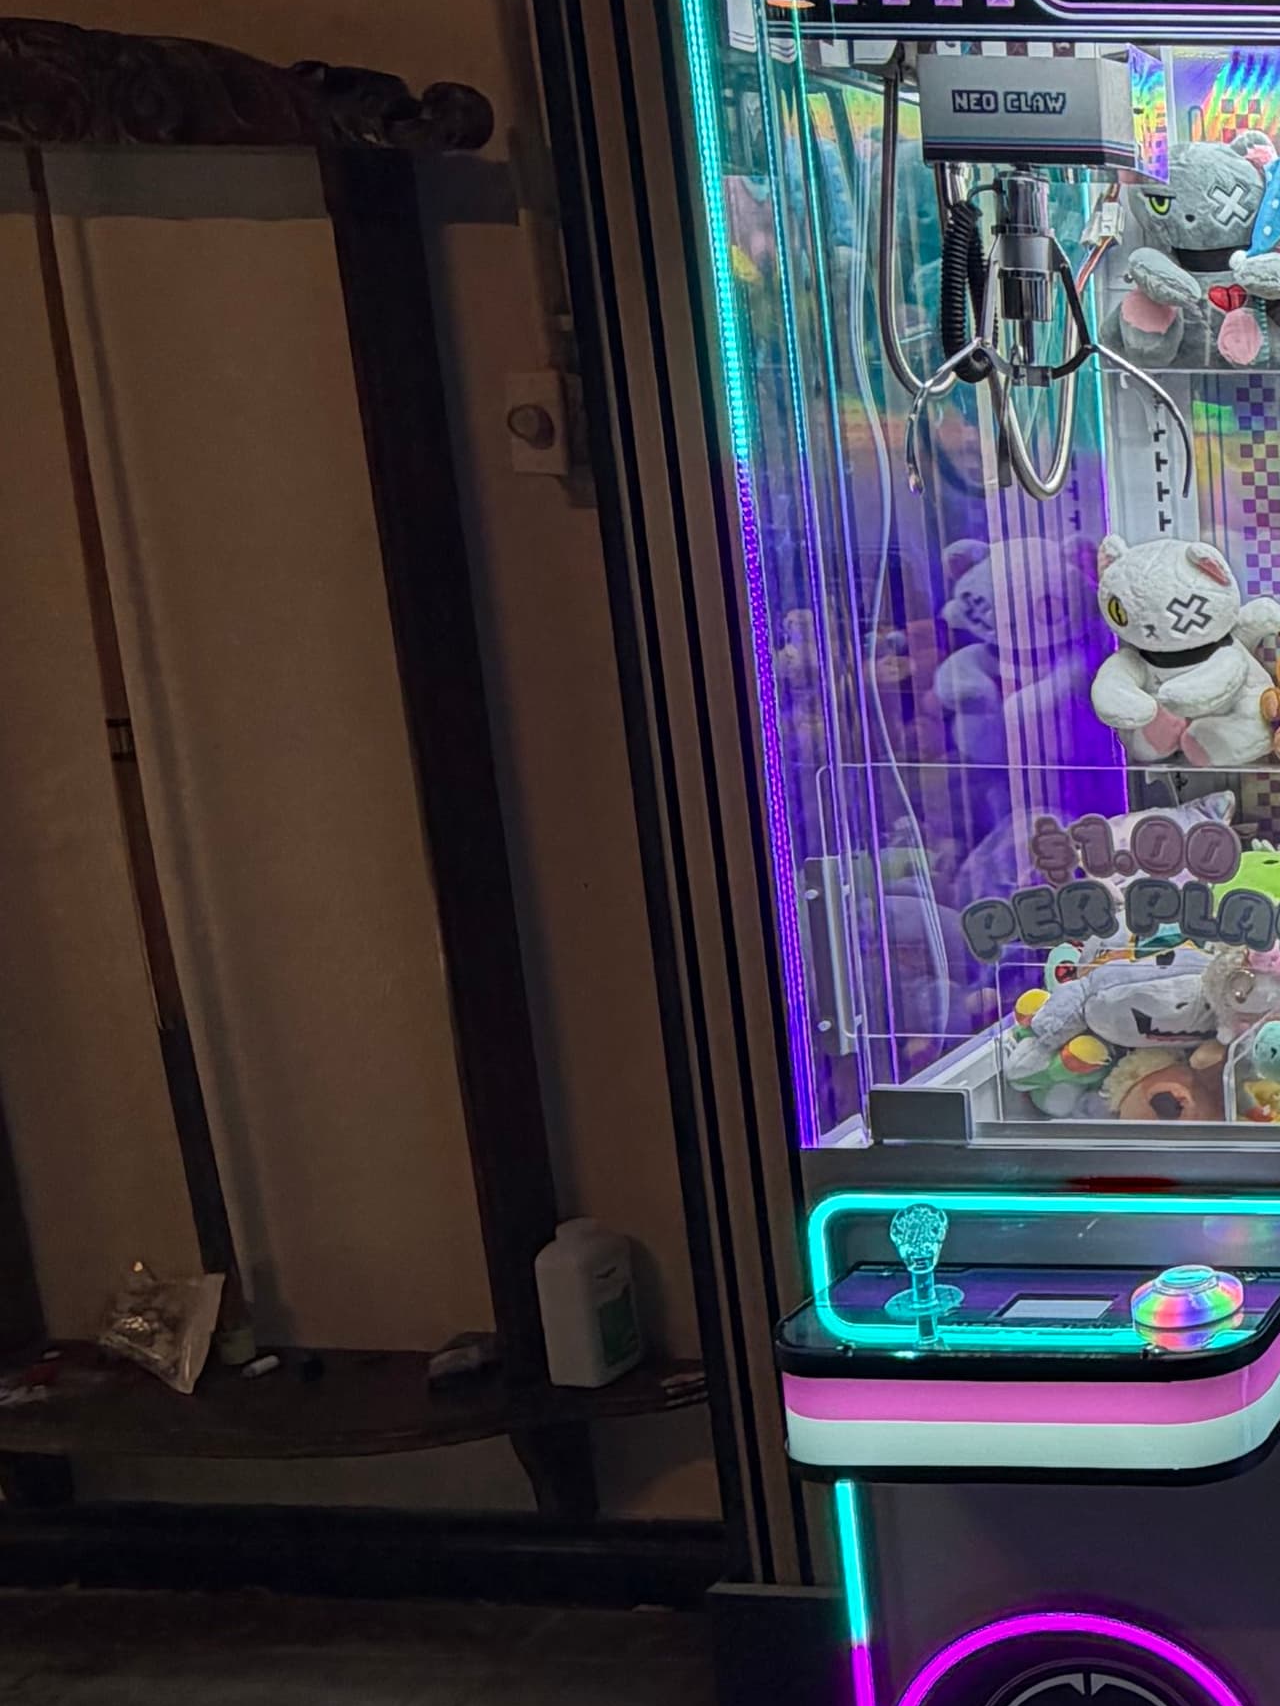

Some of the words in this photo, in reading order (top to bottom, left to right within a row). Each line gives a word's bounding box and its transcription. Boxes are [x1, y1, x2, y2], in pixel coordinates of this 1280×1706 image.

[953, 92, 998, 113] NEO
[1005, 92, 1066, 114] CLAW
[1032, 813, 1241, 886] $1.00
[962, 879, 1119, 964] PER
